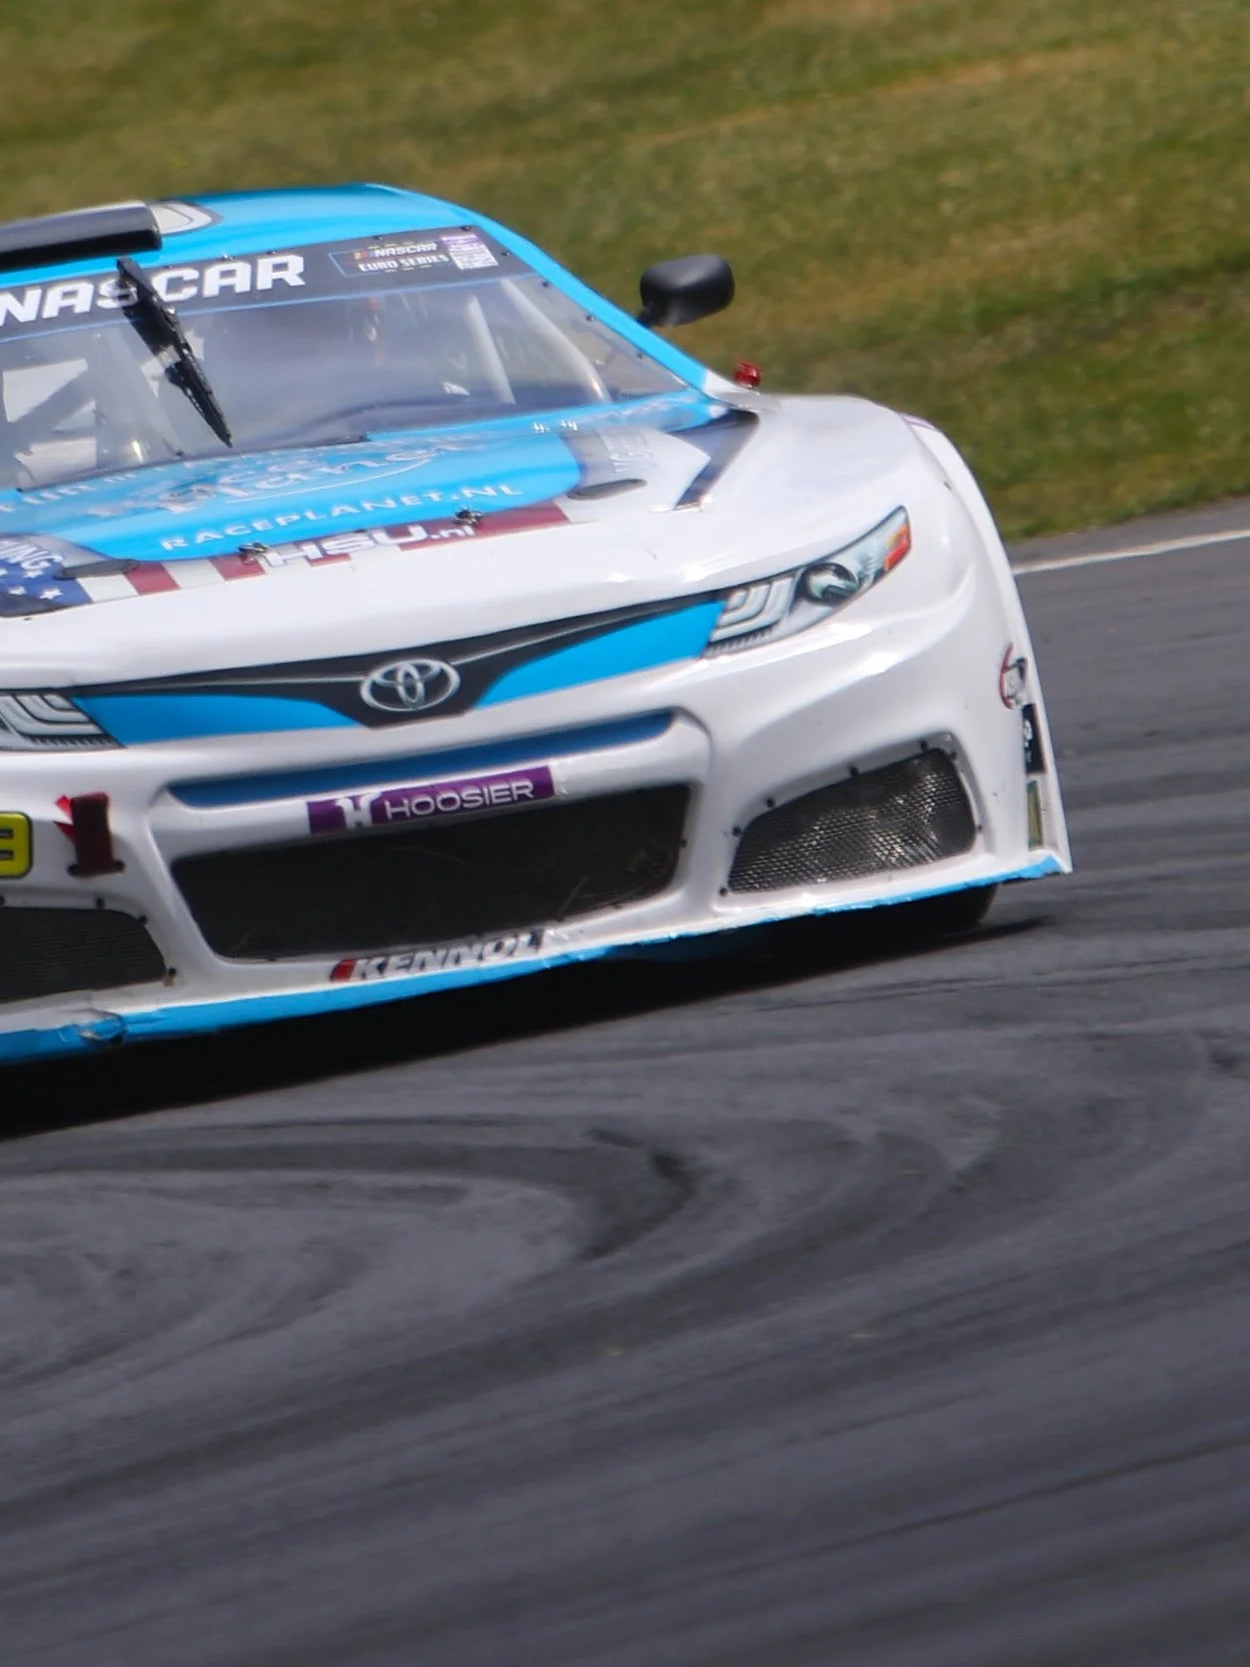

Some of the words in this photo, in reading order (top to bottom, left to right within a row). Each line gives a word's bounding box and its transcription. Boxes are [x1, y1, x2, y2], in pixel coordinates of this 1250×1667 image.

[358, 259, 399, 273] EURO
[400, 253, 451, 268] SERIES
[374, 242, 438, 258] NASCAR
[159, 483, 524, 552] RACEPLANET.NL
[384, 780, 535, 821] HOOSIER
[352, 926, 547, 983] KENNOL
